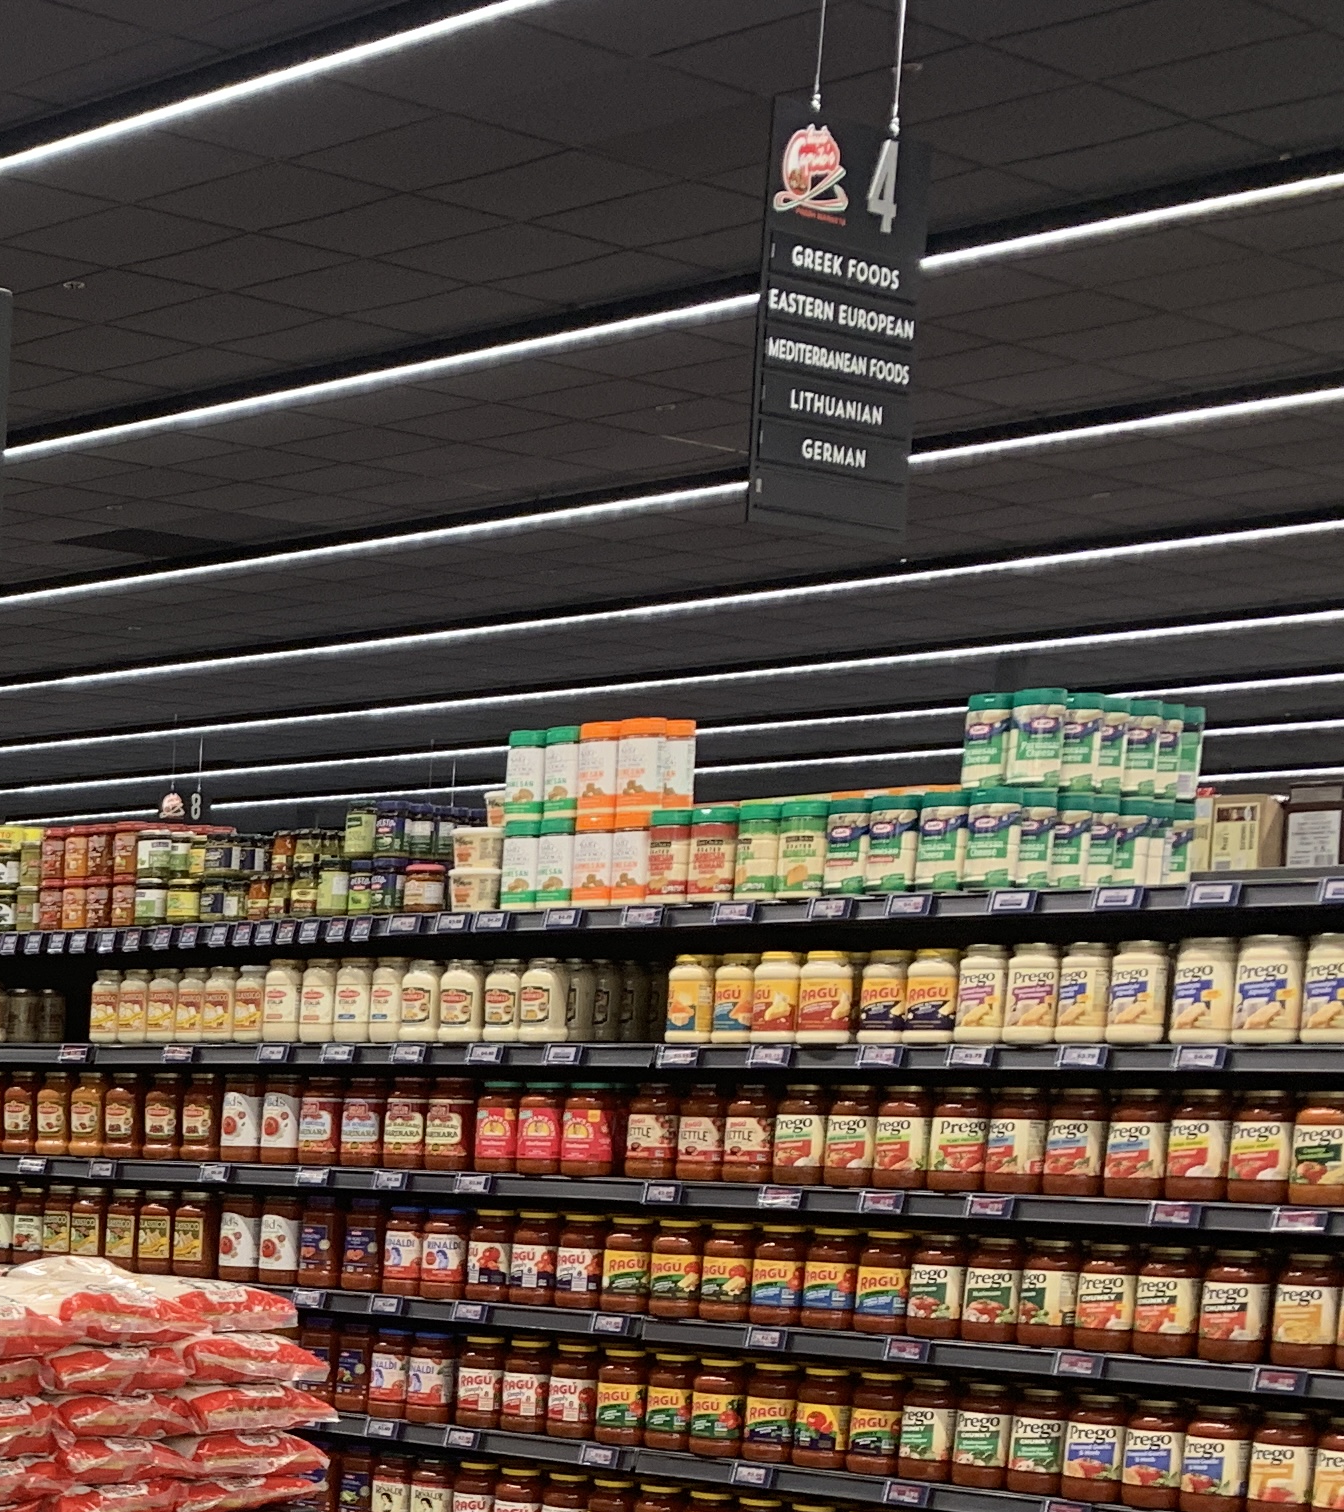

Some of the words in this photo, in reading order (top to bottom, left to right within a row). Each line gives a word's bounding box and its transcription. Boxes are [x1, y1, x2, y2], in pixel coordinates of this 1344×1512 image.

[867, 139, 899, 234] 4
[792, 245, 842, 277] GREEK
[847, 259, 900, 291] FOODS
[769, 288, 834, 322] EASTERN
[838, 307, 914, 340] EUROPEAN
[768, 337, 867, 377] MEDITERRANEAN
[870, 358, 910, 385] FOODS
[790, 389, 883, 425] LITHUANIAN
[801, 439, 866, 468] GERMAN
[190, 794, 201, 820] 8
[1014, 971, 1054, 985] Prego
[1239, 964, 1288, 980] Prego
[909, 982, 949, 1000] RAGÚ
[941, 1120, 987, 1136] Prego
[1232, 1124, 1280, 1142] Prego
[1294, 1128, 1343, 1147] Prego
[609, 1255, 646, 1272] RAGÚ
[968, 1271, 1012, 1288] Prego
[1080, 1276, 1124, 1293] Prego
[460, 1371, 492, 1385] RAGÚ
[958, 1413, 1000, 1433] Prego
[1015, 1419, 1061, 1438] Prego
[1070, 1425, 1116, 1446] Prego
[1127, 1432, 1172, 1450] Prego
[454, 1497, 486, 1510] RAGÚ
